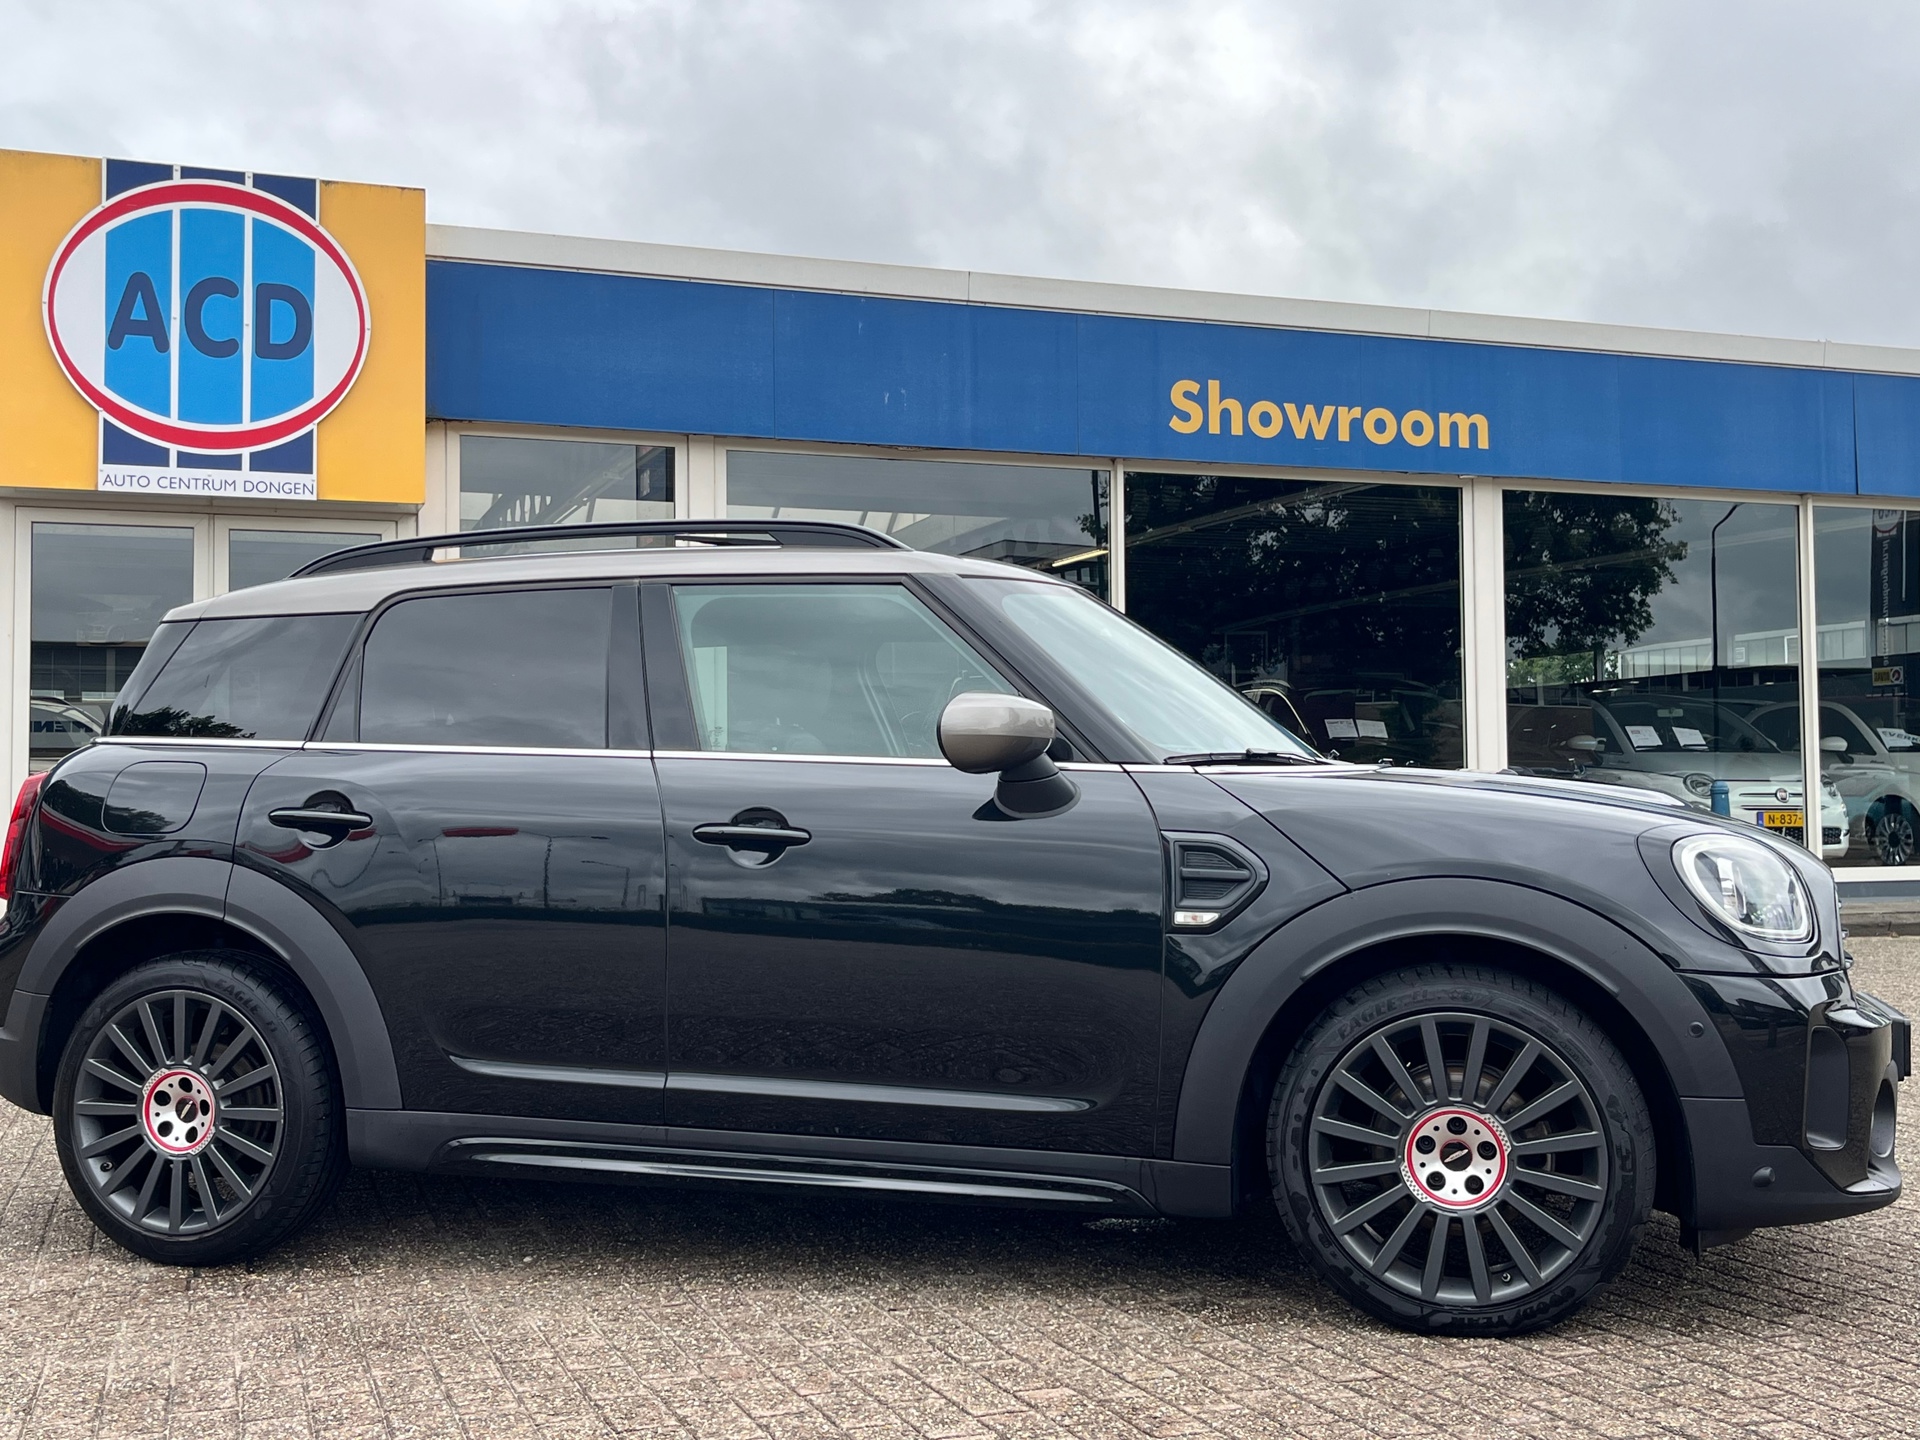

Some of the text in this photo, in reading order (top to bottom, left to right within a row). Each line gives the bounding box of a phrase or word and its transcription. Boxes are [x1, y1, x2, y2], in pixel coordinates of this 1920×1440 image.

[107, 271, 313, 360] ACD
[1168, 379, 1490, 450] Showroom
[102, 473, 315, 496] AUTO CENTRUM DONGEN
[1768, 813, 1803, 825] N-837-
